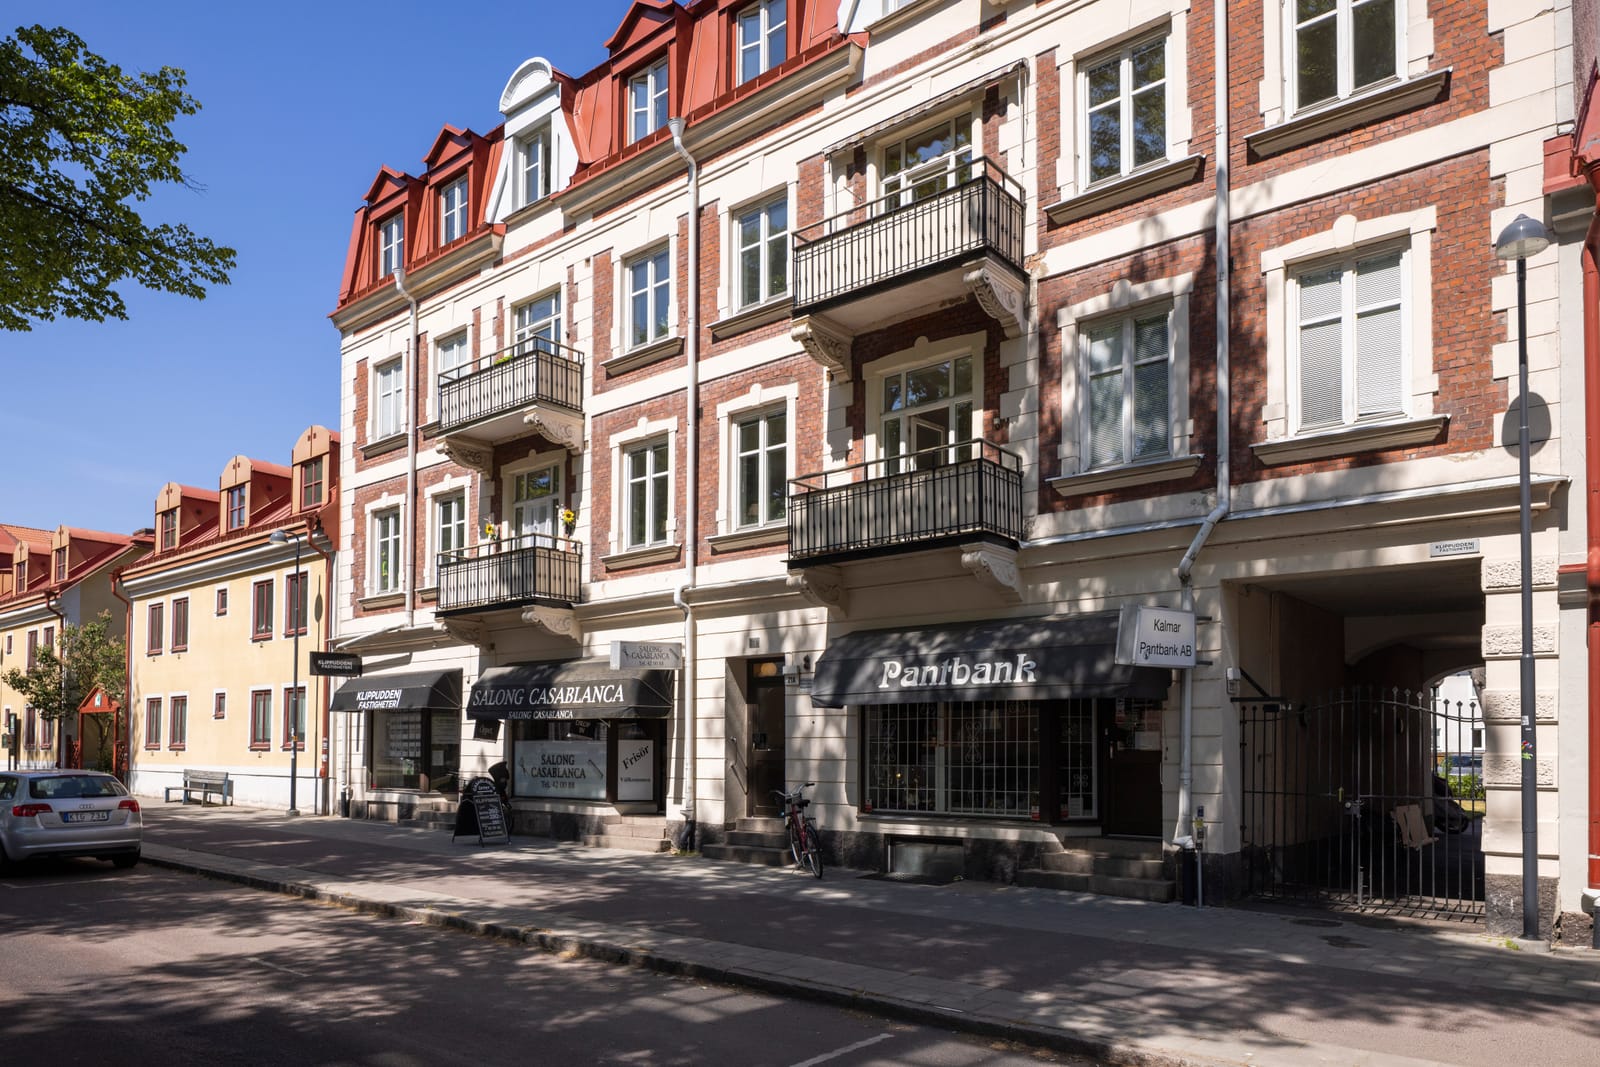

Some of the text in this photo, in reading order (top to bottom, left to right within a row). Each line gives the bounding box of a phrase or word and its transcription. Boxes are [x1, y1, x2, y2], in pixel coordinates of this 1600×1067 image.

[1153, 618, 1182, 633] Kalmar
[639, 645, 662, 653] SALONG
[1140, 641, 1192, 657] Pantbank AB
[631, 652, 670, 660] CASABLANCA
[878, 653, 1037, 689] Pantbank
[356, 689, 401, 701] KLIPPUDDEN
[473, 684, 625, 706] SALONG CASABLANCA
[357, 700, 398, 709] FASTIGHETER
[508, 709, 574, 720] SALONG CASABLANCA
[541, 754, 575, 766] SALONG
[622, 745, 649, 769] Frisör
[531, 767, 587, 779] CASABLANCA
[552, 781, 558, 789] 42
